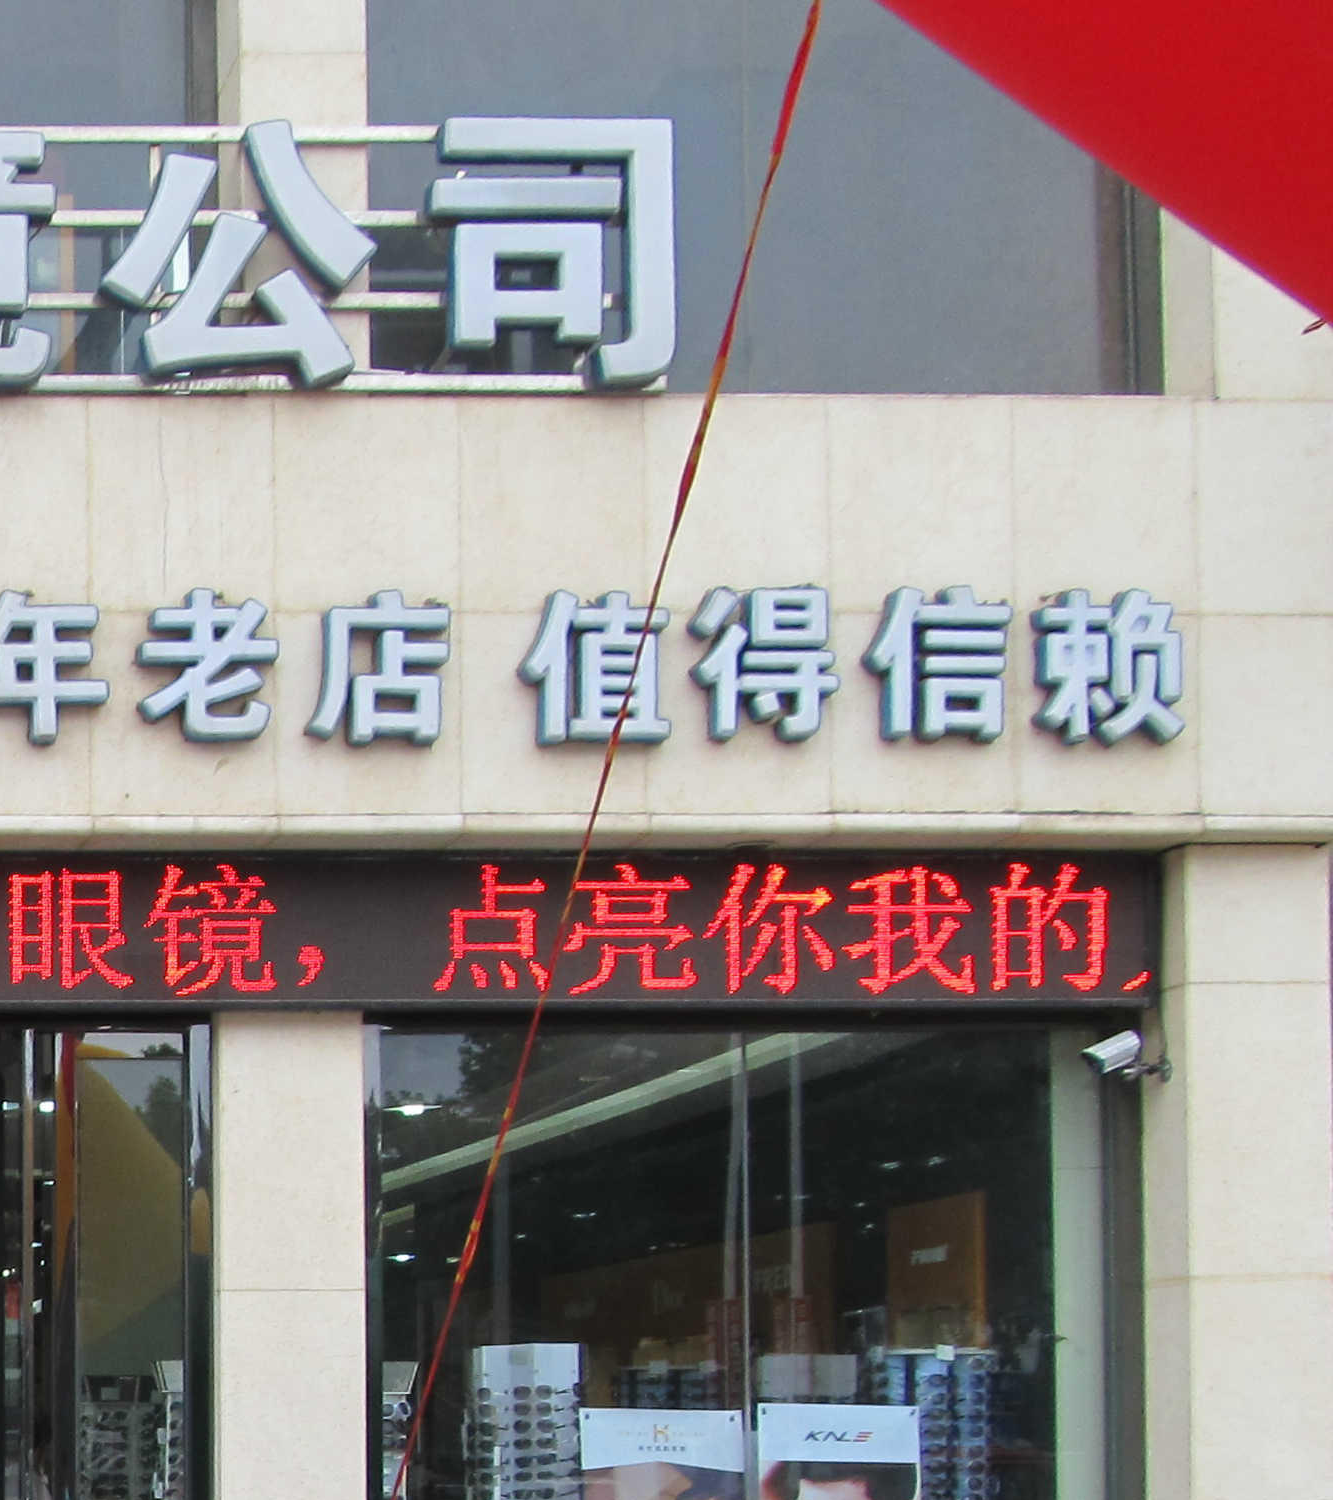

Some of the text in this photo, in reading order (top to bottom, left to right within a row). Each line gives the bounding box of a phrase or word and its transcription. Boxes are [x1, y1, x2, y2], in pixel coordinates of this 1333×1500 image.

[517, 585, 1187, 747] 值得信赖
[433, 862, 1151, 998] 点亮你我的
